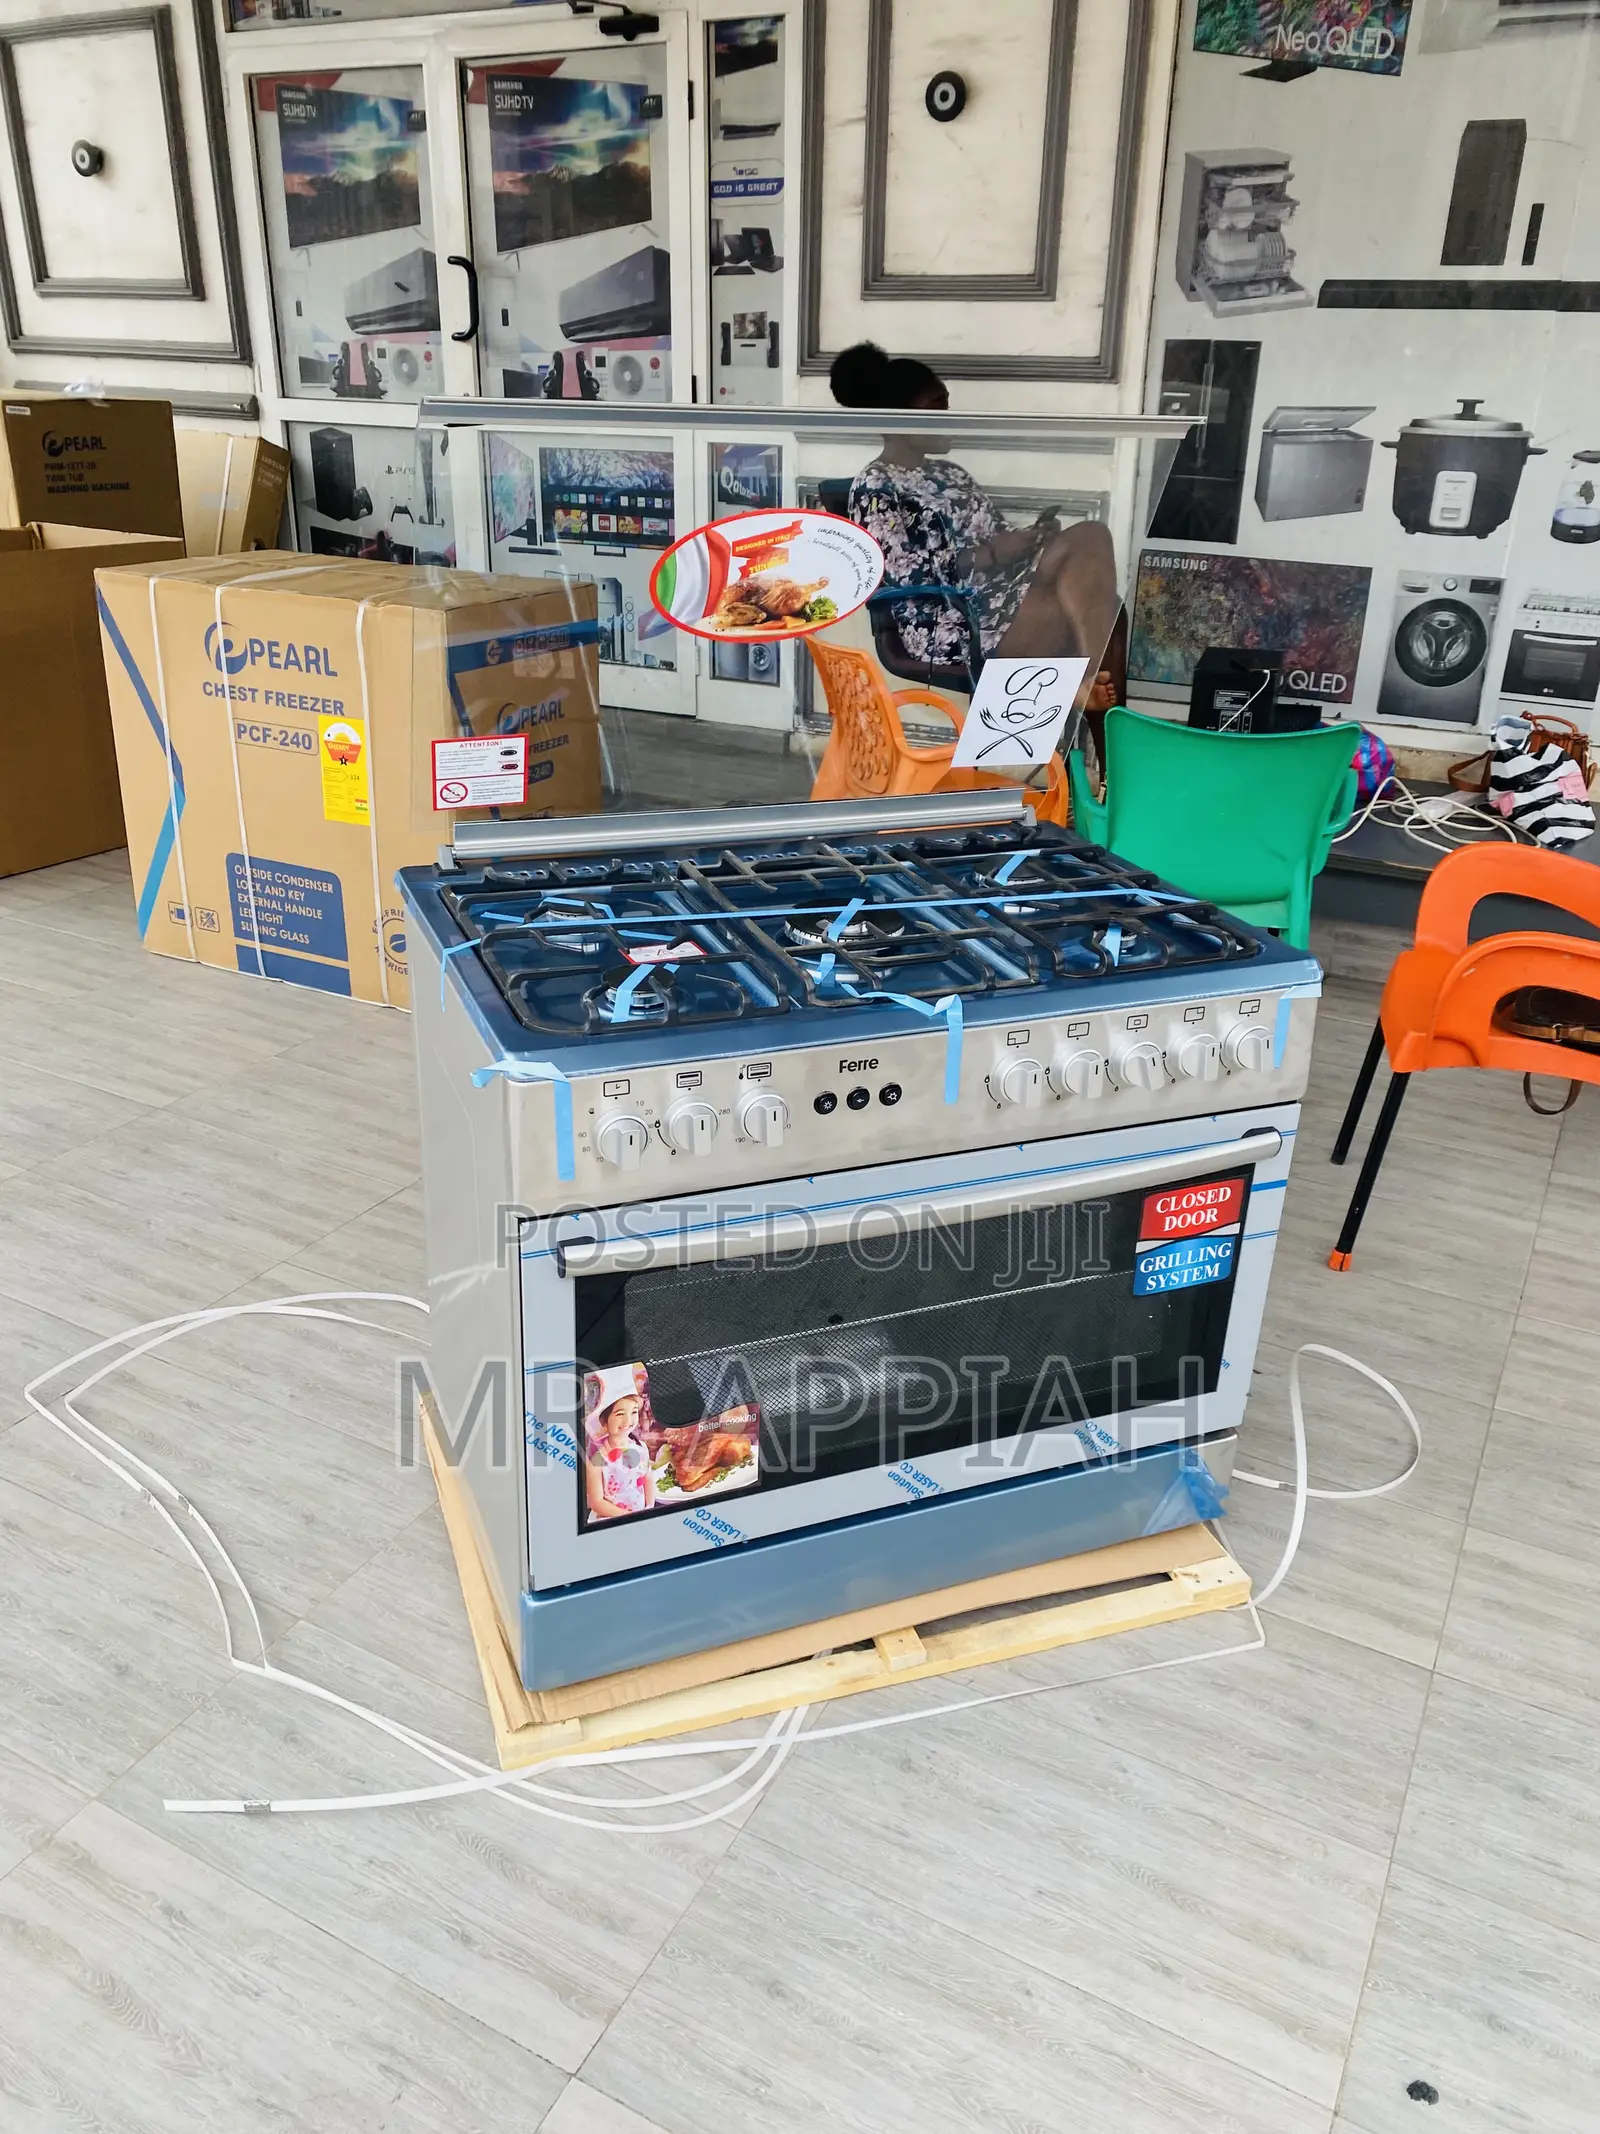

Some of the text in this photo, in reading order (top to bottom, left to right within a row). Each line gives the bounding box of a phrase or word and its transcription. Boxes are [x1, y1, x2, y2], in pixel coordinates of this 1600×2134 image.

[1275, 23, 1396, 59] Neo QLED
[64, 435, 107, 452] PEARL
[1144, 555, 1209, 571] SAMSUNG
[249, 637, 338, 678] PEARL
[1288, 669, 1348, 695] QLED
[264, 690, 345, 716] FREEZER
[520, 699, 565, 729] PEARL
[236, 722, 313, 751] PCF-240
[234, 864, 334, 894] OUSIDE CONDENSER
[237, 893, 323, 920] EXERNAL HANDLE
[264, 885, 286, 898] AND
[288, 889, 305, 902] KEY
[257, 911, 284, 925] LIGHT
[279, 929, 310, 945] GLASS
[839, 1058, 879, 1074] Ferre
[719, 1108, 731, 1116] 280
[1156, 1186, 1232, 1214] CLOSED
[1162, 1207, 1219, 1232] DOOR
[1139, 1242, 1232, 1274] GRILLING
[1145, 1263, 1220, 1291] SYSTEM
[698, 1413, 757, 1432] better cooking
[526, 1433, 561, 1459] LASER
[887, 1470, 924, 1499] Solution
[912, 1469, 939, 1492] LASER
[682, 1517, 725, 1547] Solution
[710, 1516, 741, 1539] LASER
